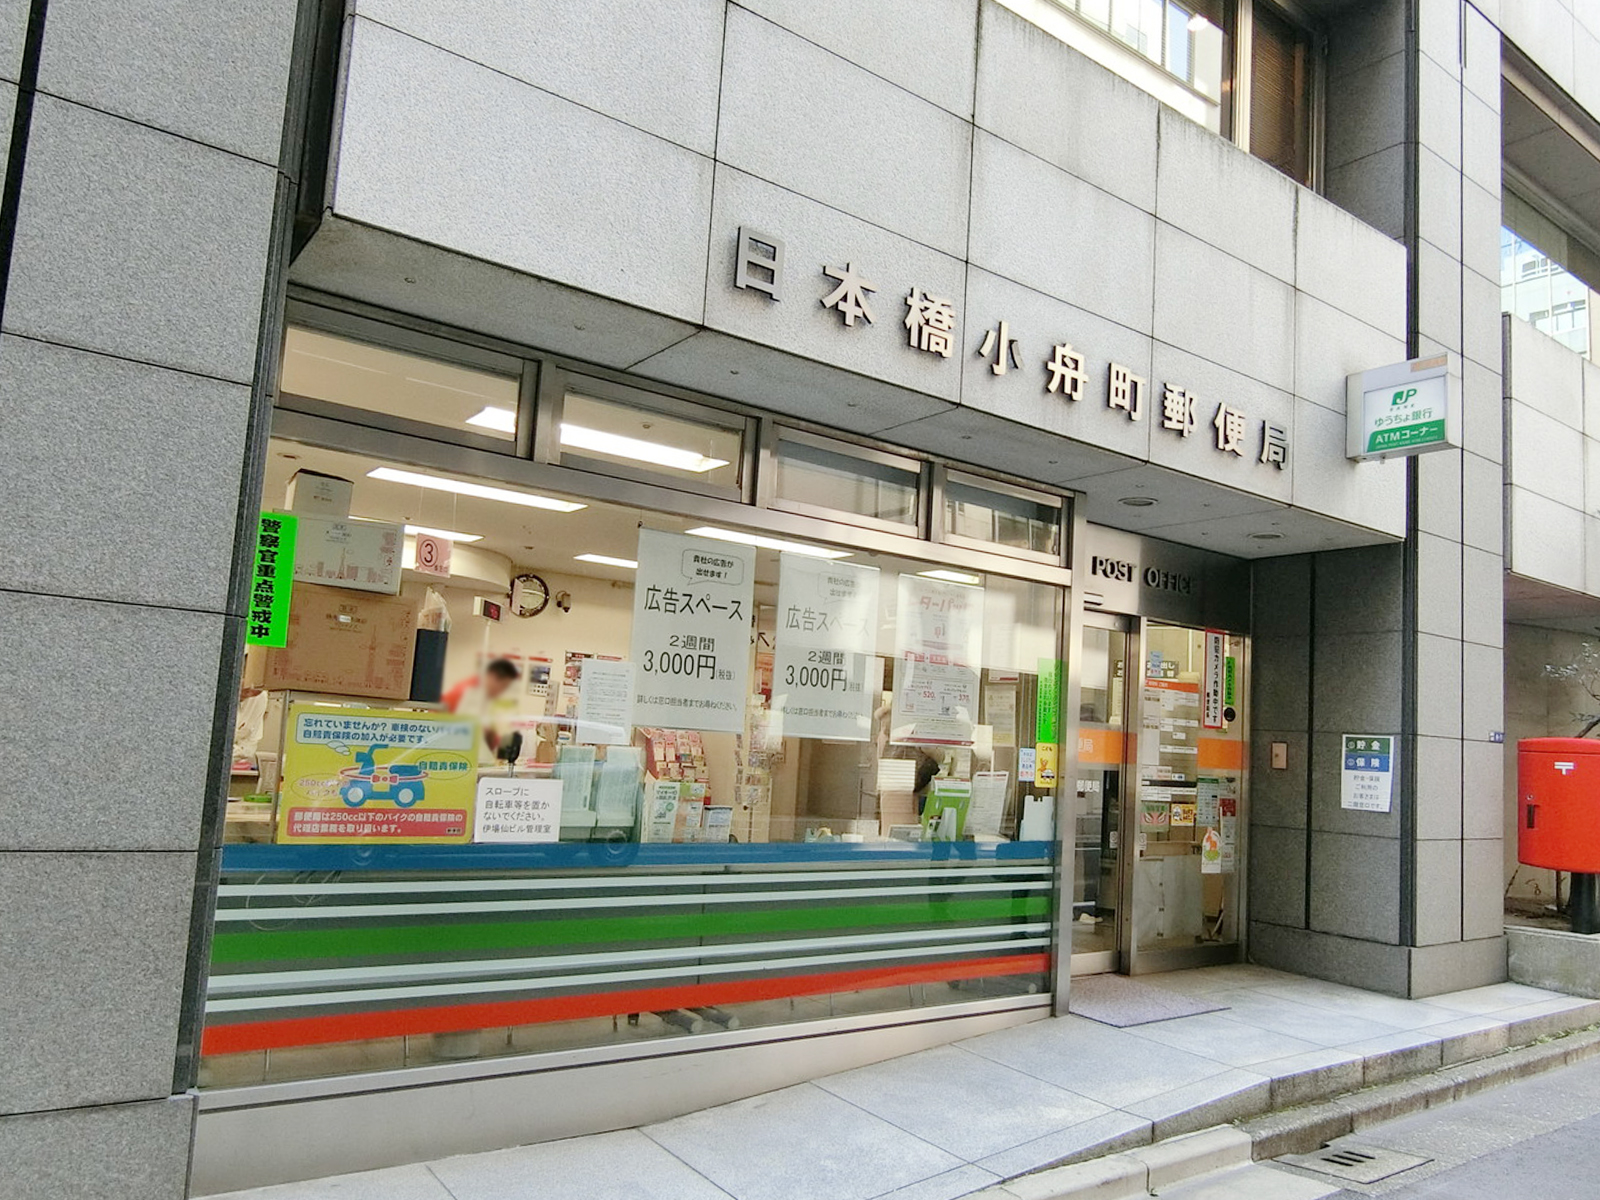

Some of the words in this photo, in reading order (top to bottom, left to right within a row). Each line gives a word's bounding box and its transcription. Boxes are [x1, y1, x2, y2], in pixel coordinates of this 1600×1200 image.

[734, 225, 1291, 471] 日本橋小舟町郵便局
[1391, 388, 1418, 406] JP
[1374, 407, 1433, 428] ゆうちょ銀行
[1375, 426, 1438, 445] ATMコーナー
[693, 554, 734, 569] 貴社の広告が
[250, 518, 282, 638] 警察官重点警戒中
[827, 575, 860, 589] 貴社の広告
[1090, 556, 1137, 582] POST
[1143, 566, 1195, 594] OFFIC
[644, 584, 743, 621] 広告スペース
[785, 604, 870, 637] 広告スペース
[669, 634, 716, 652] 2週間
[643, 649, 717, 680] 3,000円
[807, 650, 845, 666] 2週間
[303, 729, 428, 744] 自賠責保険の加入が必要です。
[1356, 740, 1381, 750] 貯金
[418, 761, 468, 771] 自賠責保険
[485, 787, 530, 796] スロープに
[485, 800, 550, 810] 自転車等を置か
[293, 811, 463, 822] 郵便局は250cc以下のバイクの自賠責保険の
[483, 811, 545, 821] ないでください。
[482, 824, 552, 833] 伊場仙ビル管理室
